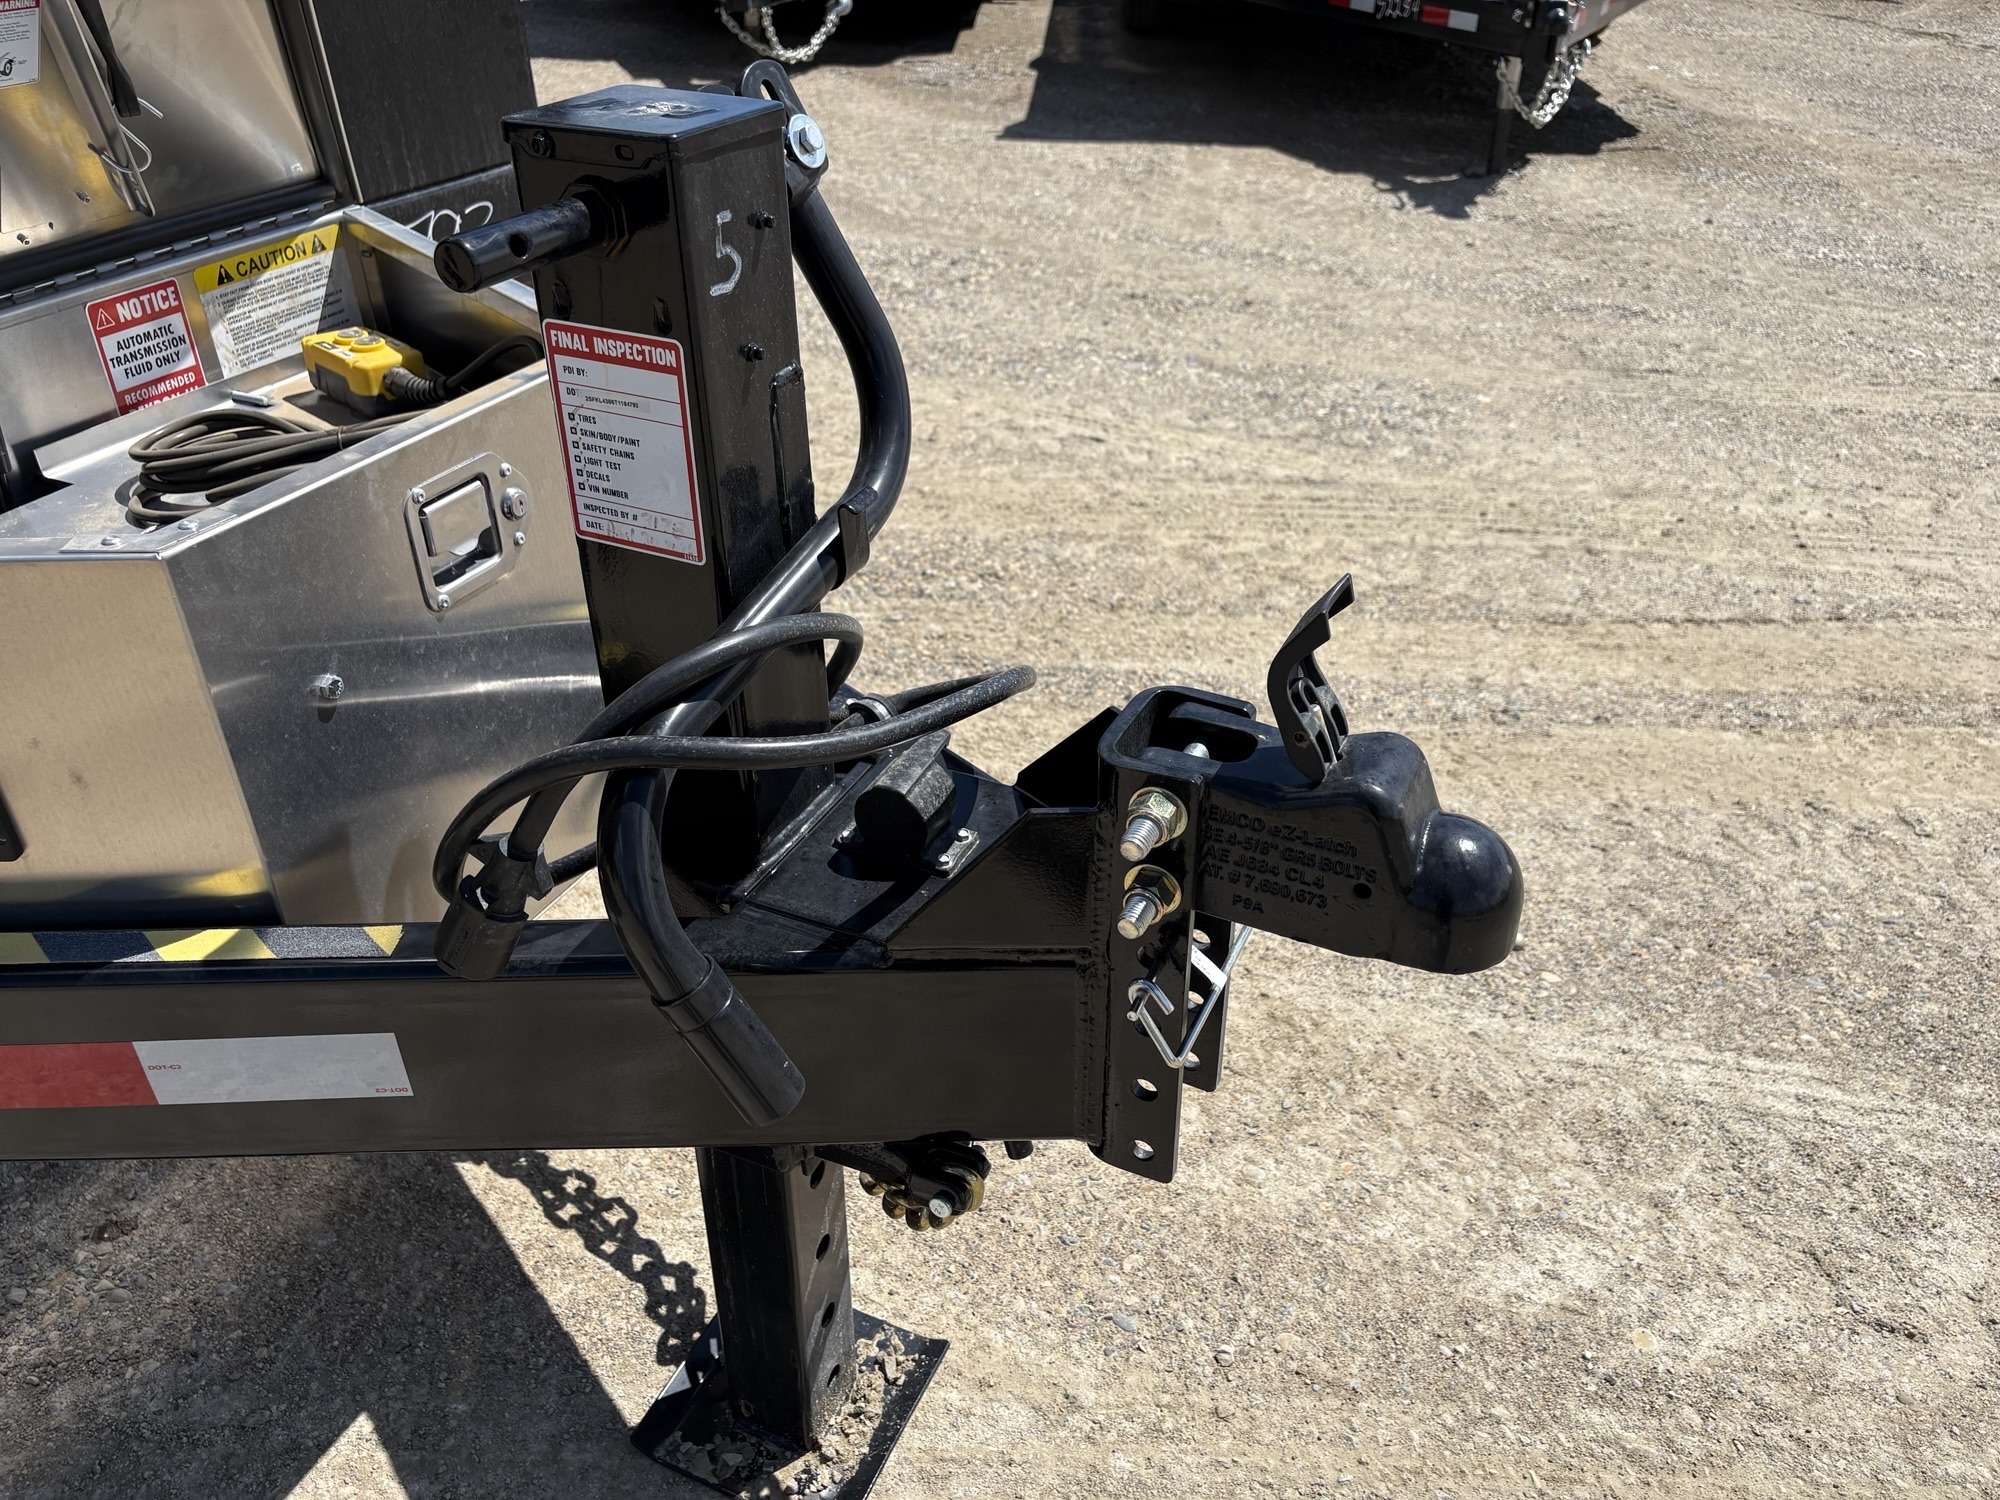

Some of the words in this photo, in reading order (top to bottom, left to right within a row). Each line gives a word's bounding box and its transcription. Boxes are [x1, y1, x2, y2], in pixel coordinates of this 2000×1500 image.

[236, 240, 307, 277] CAUTION
[710, 209, 742, 296] 5
[115, 286, 179, 323] NOTICE
[117, 323, 174, 352] AUTOMATIC
[550, 329, 589, 352] FINAL
[593, 336, 677, 368] INSPECTION
[109, 334, 187, 369] TRANSMISSION
[124, 361, 153, 379] FLUID
[155, 350, 181, 368] ONLY
[562, 365, 575, 375] PDI
[576, 368, 588, 377] BY:
[124, 371, 196, 405] RECOMMENDED
[577, 414, 597, 425] TIRES
[580, 428, 640, 447] SKIN/BODY/PAINT
[582, 442, 607, 455] SAFETY
[609, 448, 635, 460] CHAINS
[583, 456, 603, 467] LIGHT
[605, 461, 621, 471] TEST
[585, 470, 611, 482] DECALS
[588, 483, 600, 493] VIN
[602, 487, 629, 500] NUMBER
[583, 503, 619, 519] INSPECTED
[620, 511, 629, 520] BY
[586, 520, 604, 531] DATE:
[1285, 867, 1325, 889] CL4
[1318, 855, 1377, 884] BOLTS
